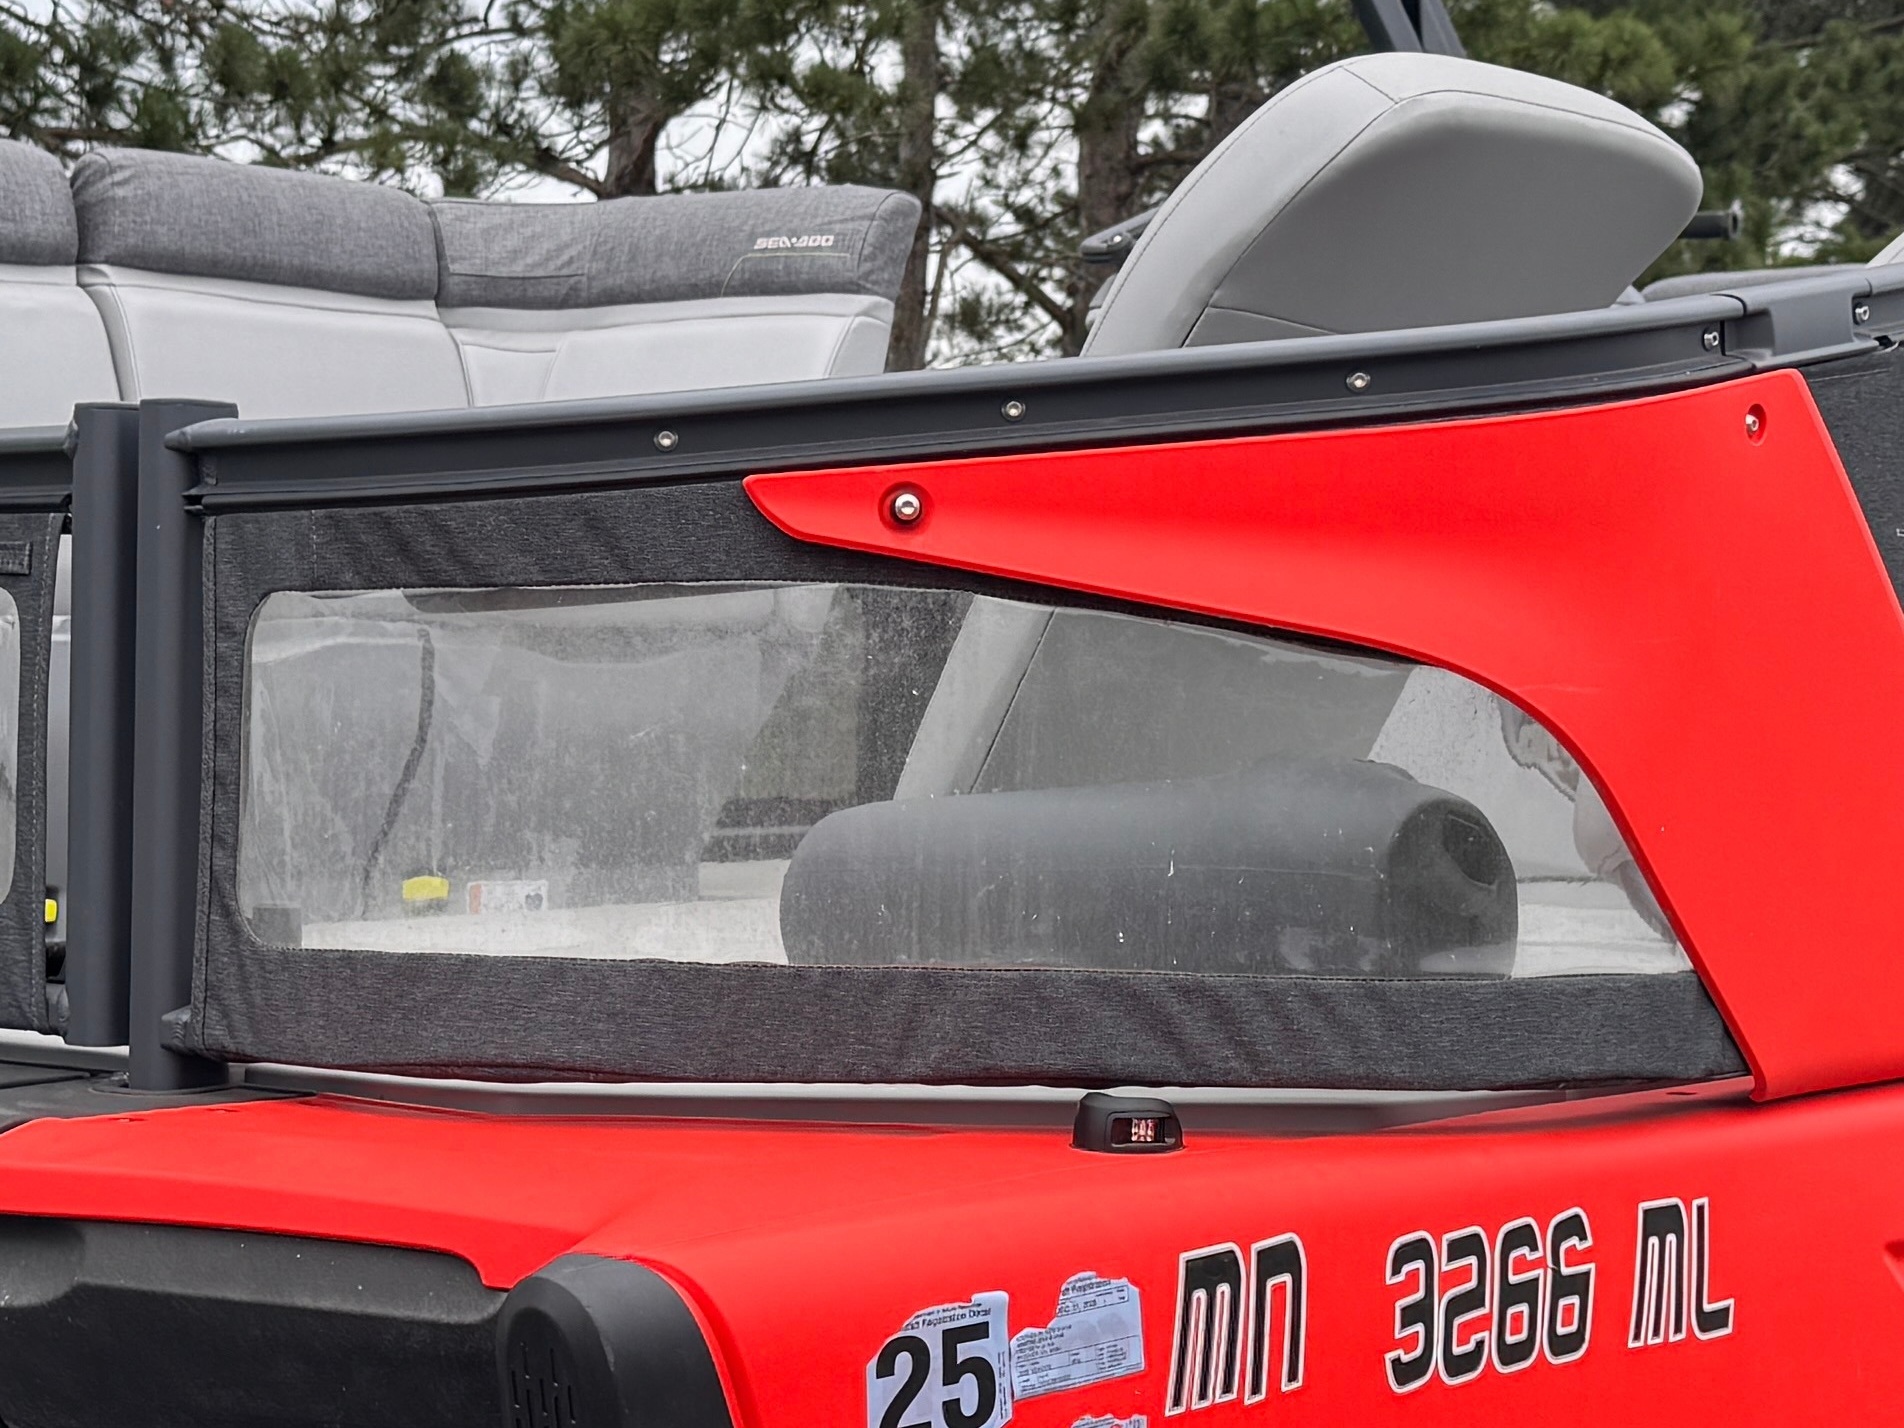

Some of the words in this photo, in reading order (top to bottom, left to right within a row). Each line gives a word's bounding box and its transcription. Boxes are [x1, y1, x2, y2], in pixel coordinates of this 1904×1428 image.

[1165, 1232, 1308, 1418] MN
[1385, 1206, 1595, 1394] 3266
[1628, 1196, 1735, 1349] ML
